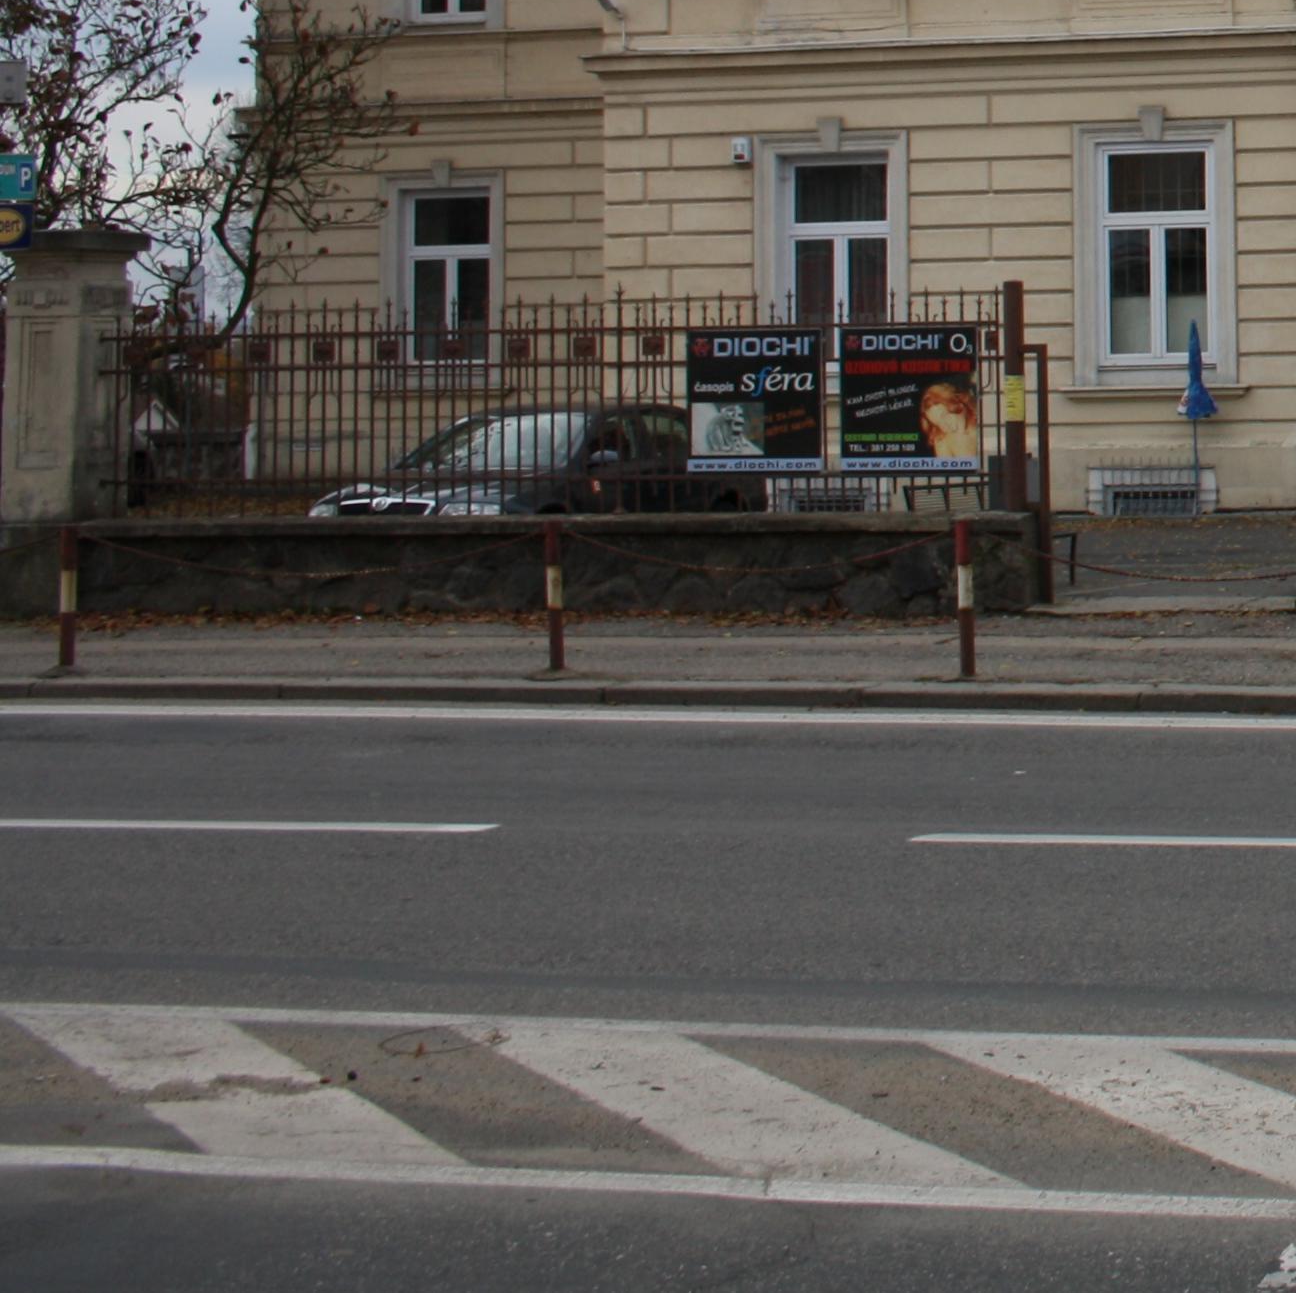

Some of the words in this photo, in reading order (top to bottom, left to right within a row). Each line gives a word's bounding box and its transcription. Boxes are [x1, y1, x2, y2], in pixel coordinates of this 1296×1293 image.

[713, 336, 810, 357] DIOCHI
[862, 334, 939, 350] DIOCHI
[741, 366, 815, 397] sféra
[694, 460, 817, 470] www.diochi.com
[847, 459, 973, 469] www.diochi.com
